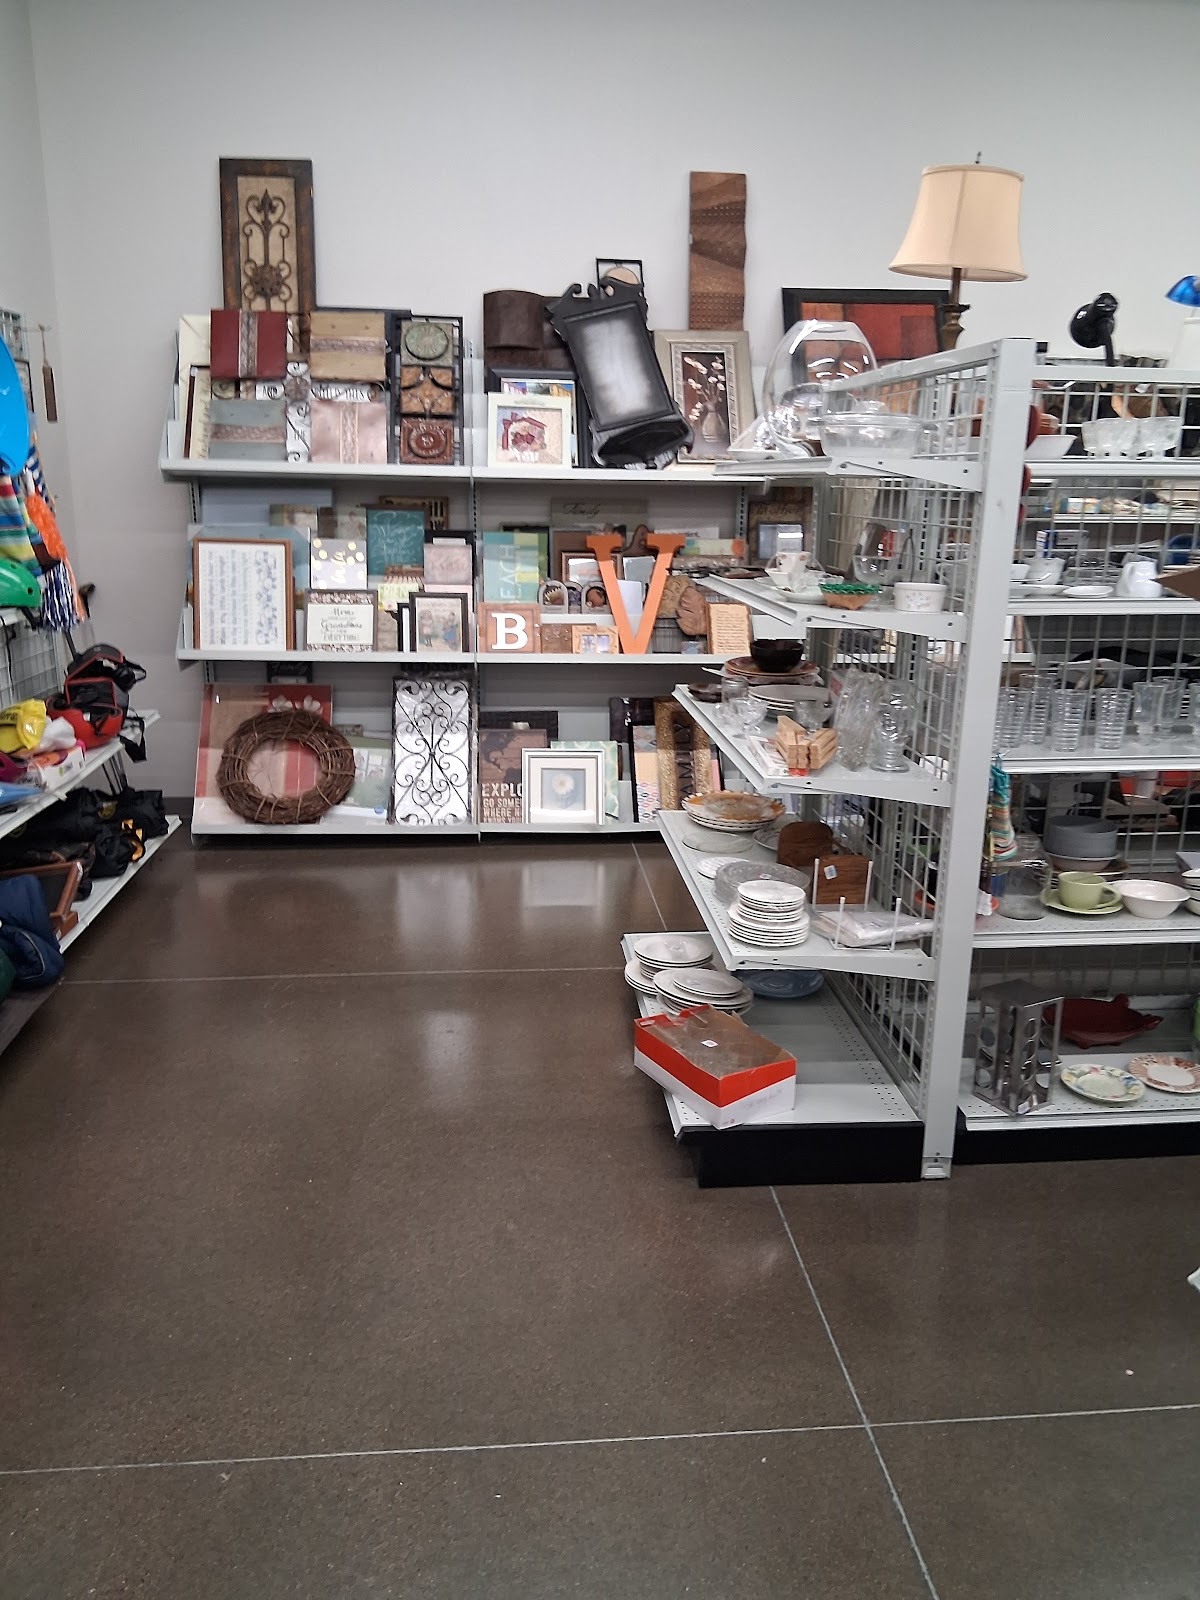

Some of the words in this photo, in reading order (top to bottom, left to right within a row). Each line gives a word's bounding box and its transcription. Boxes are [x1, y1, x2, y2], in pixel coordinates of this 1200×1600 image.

[499, 545, 521, 603] EACH
[586, 533, 685, 654] V
[491, 612, 528, 650] B
[674, 721, 695, 797] AMILY
[483, 798, 495, 808] GO
[483, 807, 512, 817] WHERE
